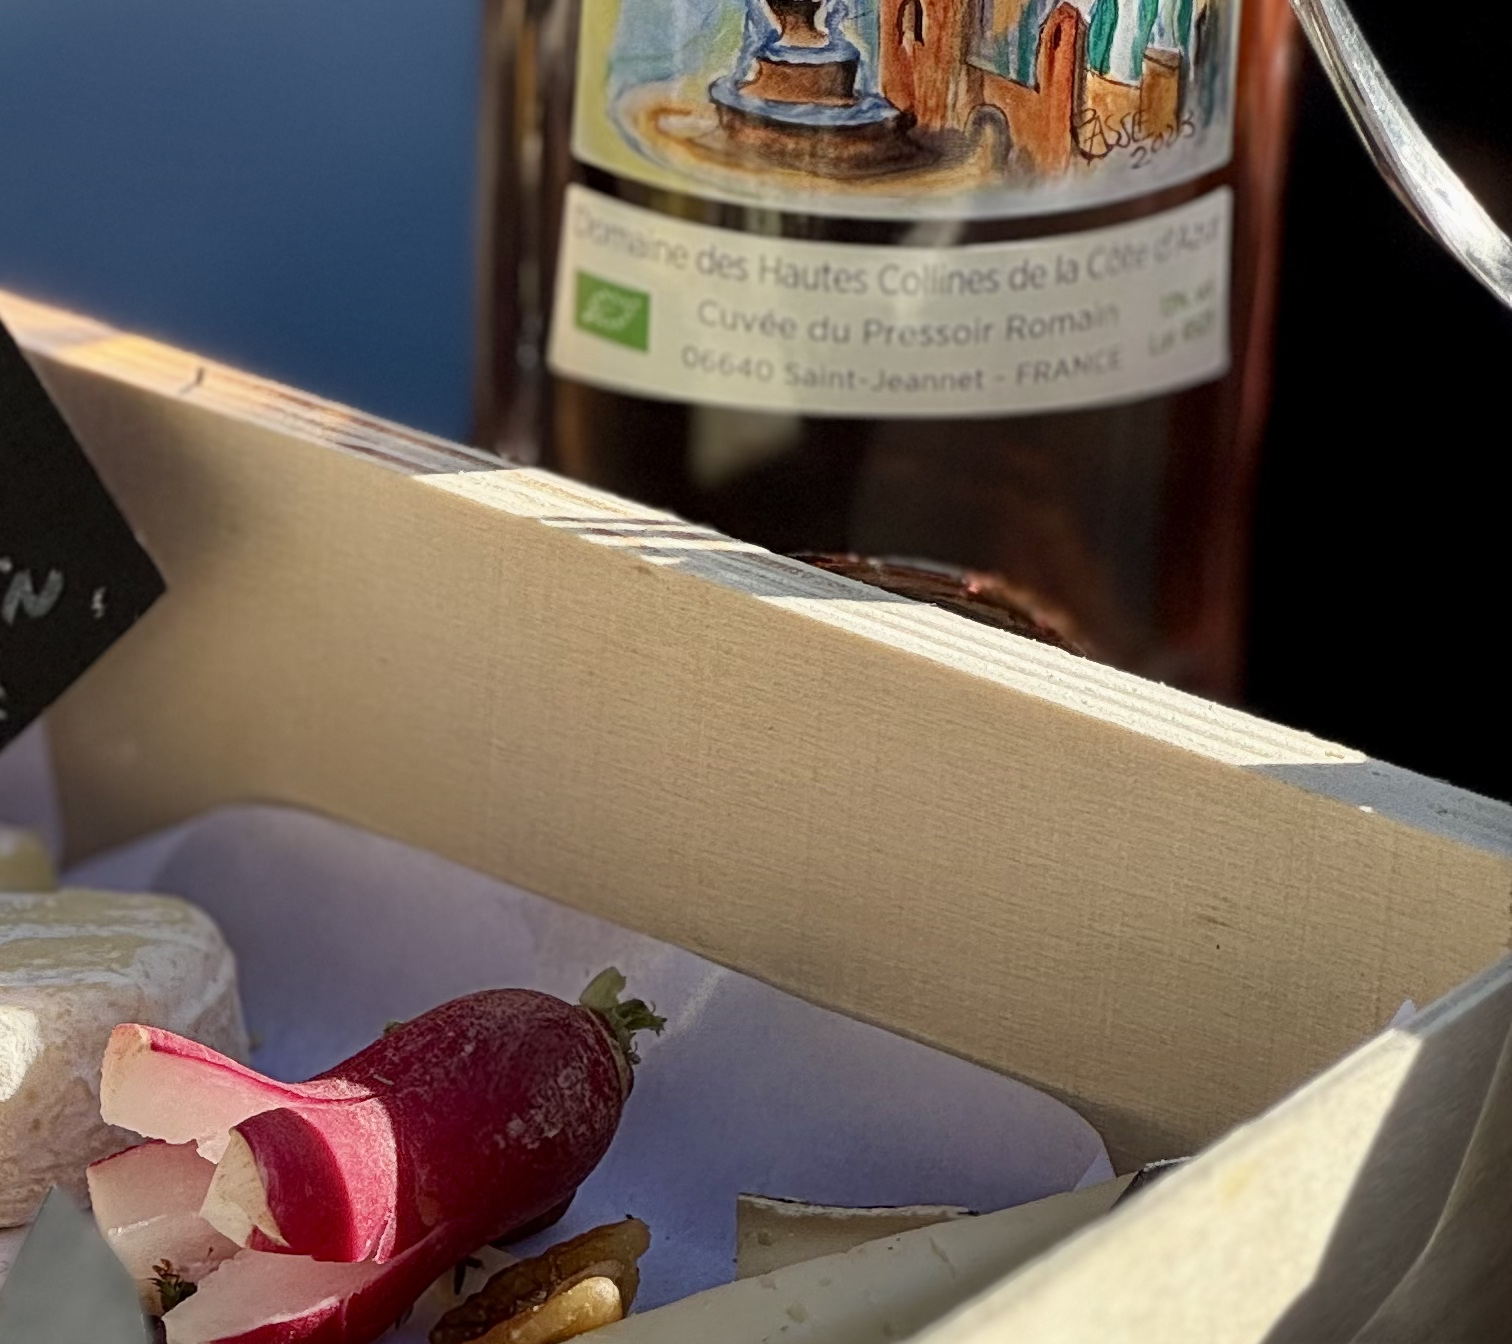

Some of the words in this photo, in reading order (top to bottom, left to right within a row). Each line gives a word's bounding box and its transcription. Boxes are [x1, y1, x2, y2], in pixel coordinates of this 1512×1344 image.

[572, 206, 688, 273] Domaine
[694, 247, 749, 284] des
[759, 253, 869, 297] Hautes
[878, 263, 1001, 299] Collines
[1007, 253, 1048, 291] de
[1054, 249, 1080, 285] la
[697, 299, 796, 337] Cuvée
[808, 313, 852, 346] du
[862, 312, 994, 348] Pressoir
[1006, 296, 1122, 343] Romain
[682, 343, 775, 386] 06640
[784, 360, 986, 394] Saint-Jeannet
[1016, 346, 1123, 387] FRANCE
